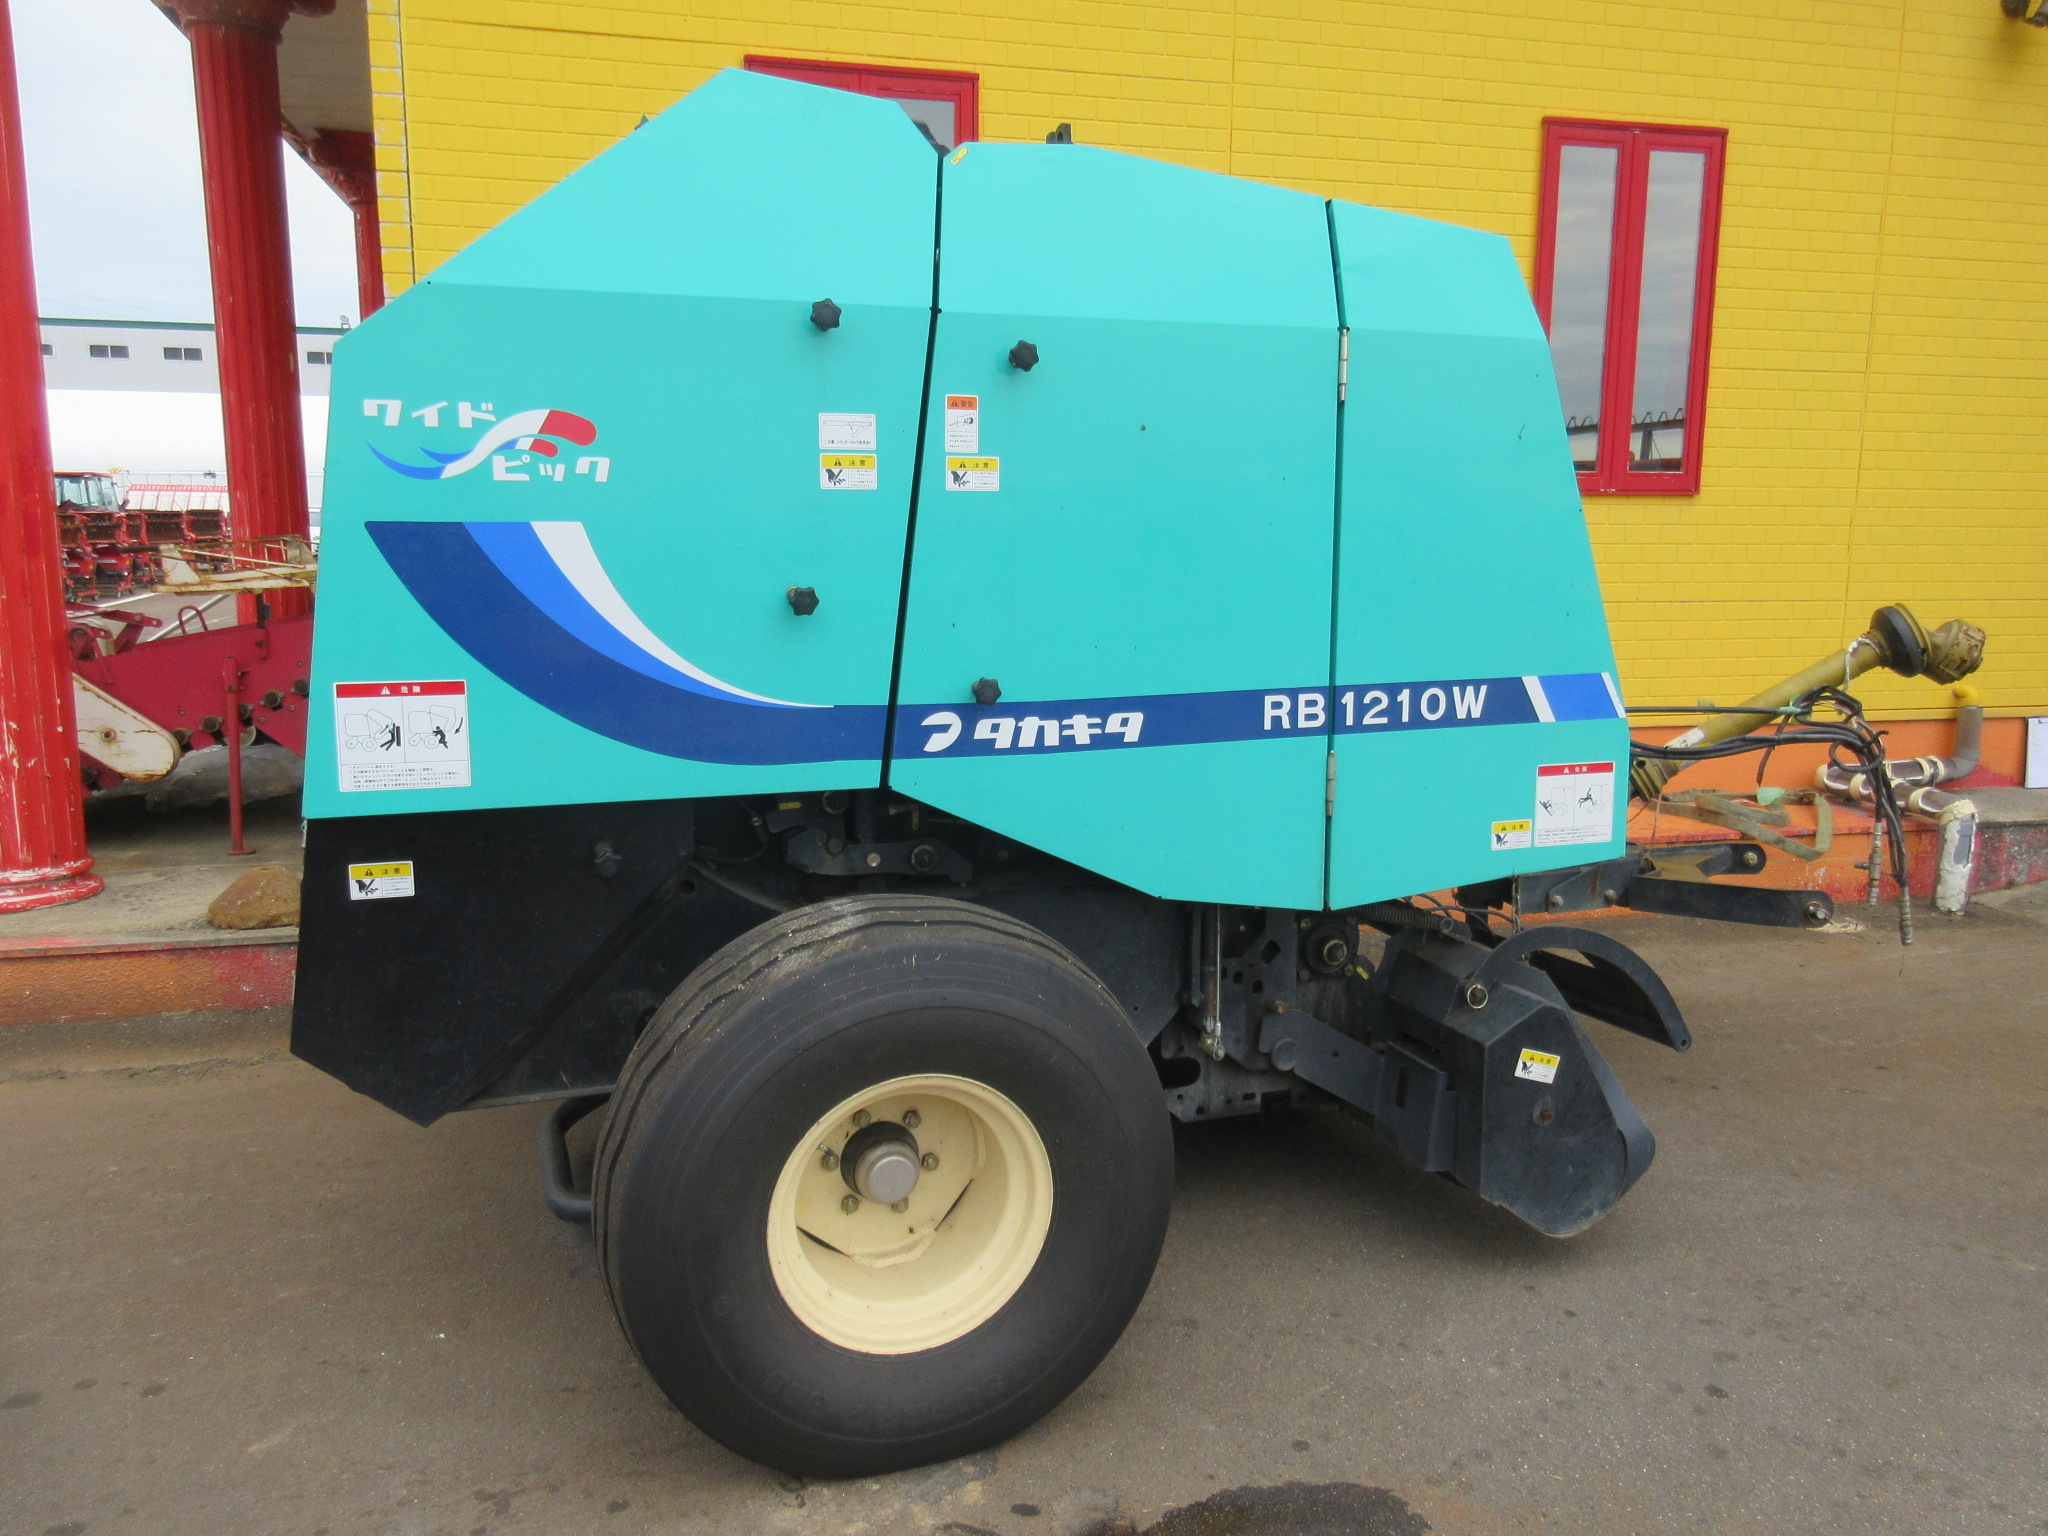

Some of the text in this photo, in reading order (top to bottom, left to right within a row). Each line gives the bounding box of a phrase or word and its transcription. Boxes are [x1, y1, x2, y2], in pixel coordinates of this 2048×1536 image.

[363, 399, 497, 428] ワイド
[492, 454, 611, 483] ピック
[848, 459, 866, 467] 注意
[400, 685, 421, 694] 危険
[973, 712, 1144, 749] タカキタ
[381, 867, 401, 875] 注意
